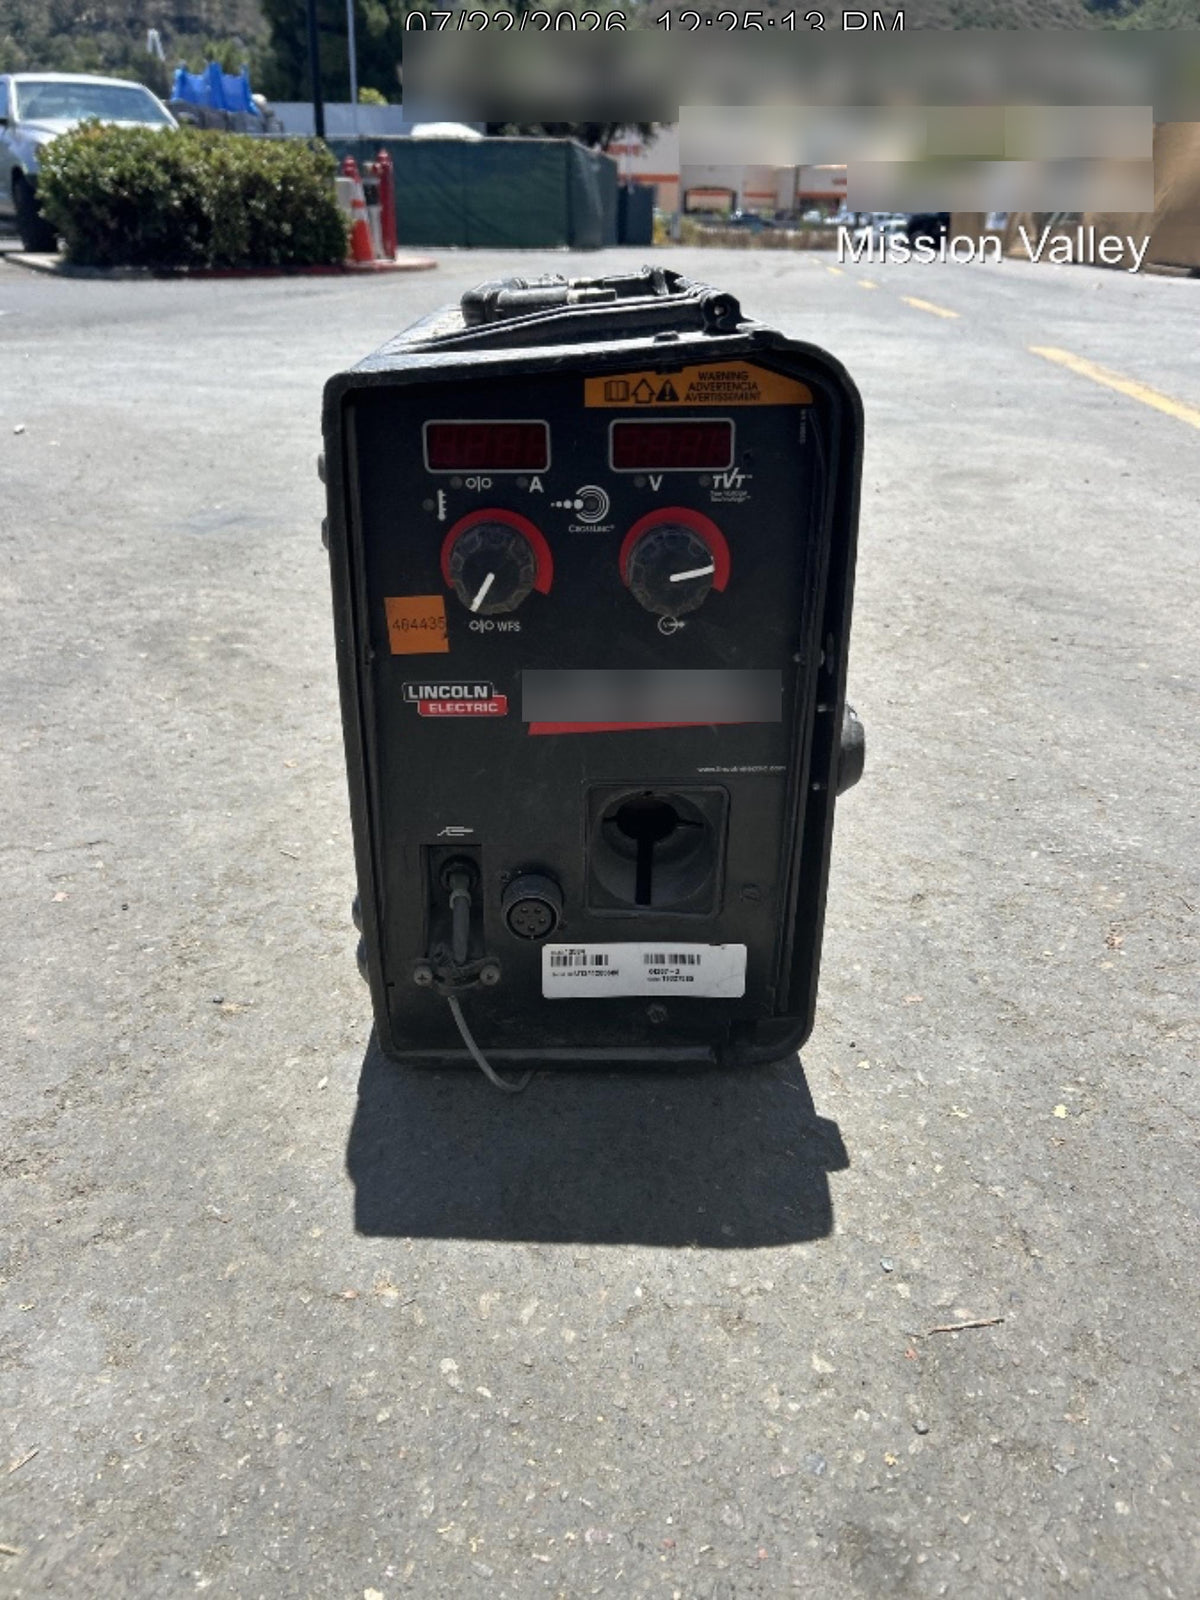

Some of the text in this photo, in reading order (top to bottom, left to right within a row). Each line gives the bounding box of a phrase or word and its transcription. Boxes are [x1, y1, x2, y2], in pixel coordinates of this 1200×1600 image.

[698, 371, 749, 381] WARNING
[689, 382, 758, 391] ADVERTENCIA
[529, 476, 544, 493] A
[649, 475, 663, 491] V
[497, 621, 521, 632] WFS
[408, 685, 488, 700] LINCOLN
[429, 703, 499, 713] ELECTRIC
